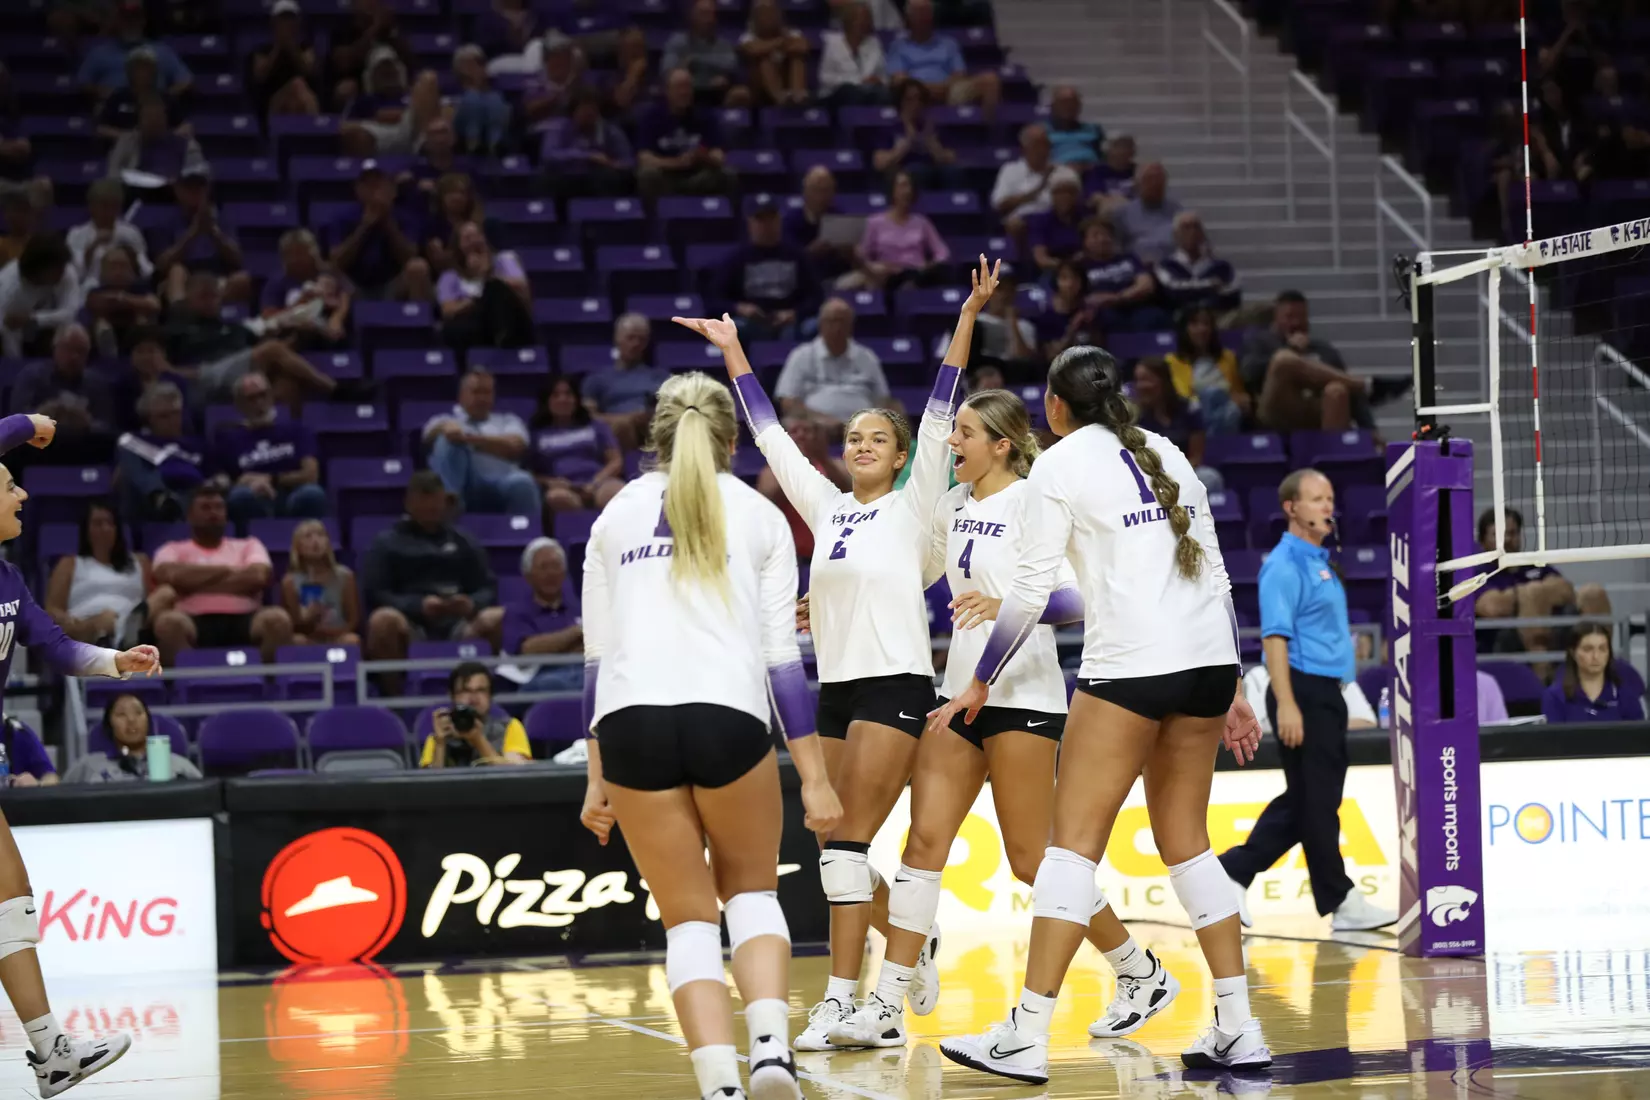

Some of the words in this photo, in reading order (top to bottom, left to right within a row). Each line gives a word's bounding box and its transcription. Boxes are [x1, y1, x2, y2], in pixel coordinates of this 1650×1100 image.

[1552, 232, 1592, 257] K-STATE
[952, 518, 1006, 538] K-STATE
[1123, 505, 1196, 528] WILDTS
[958, 538, 974, 579] 4
[1390, 531, 1418, 873] K-STATE
[1440, 746, 1458, 801] sports
[1441, 803, 1461, 871] imports
[1489, 799, 1650, 845] POINTE
[421, 853, 635, 938] Pizza
[1264, 875, 1378, 900] EAS
